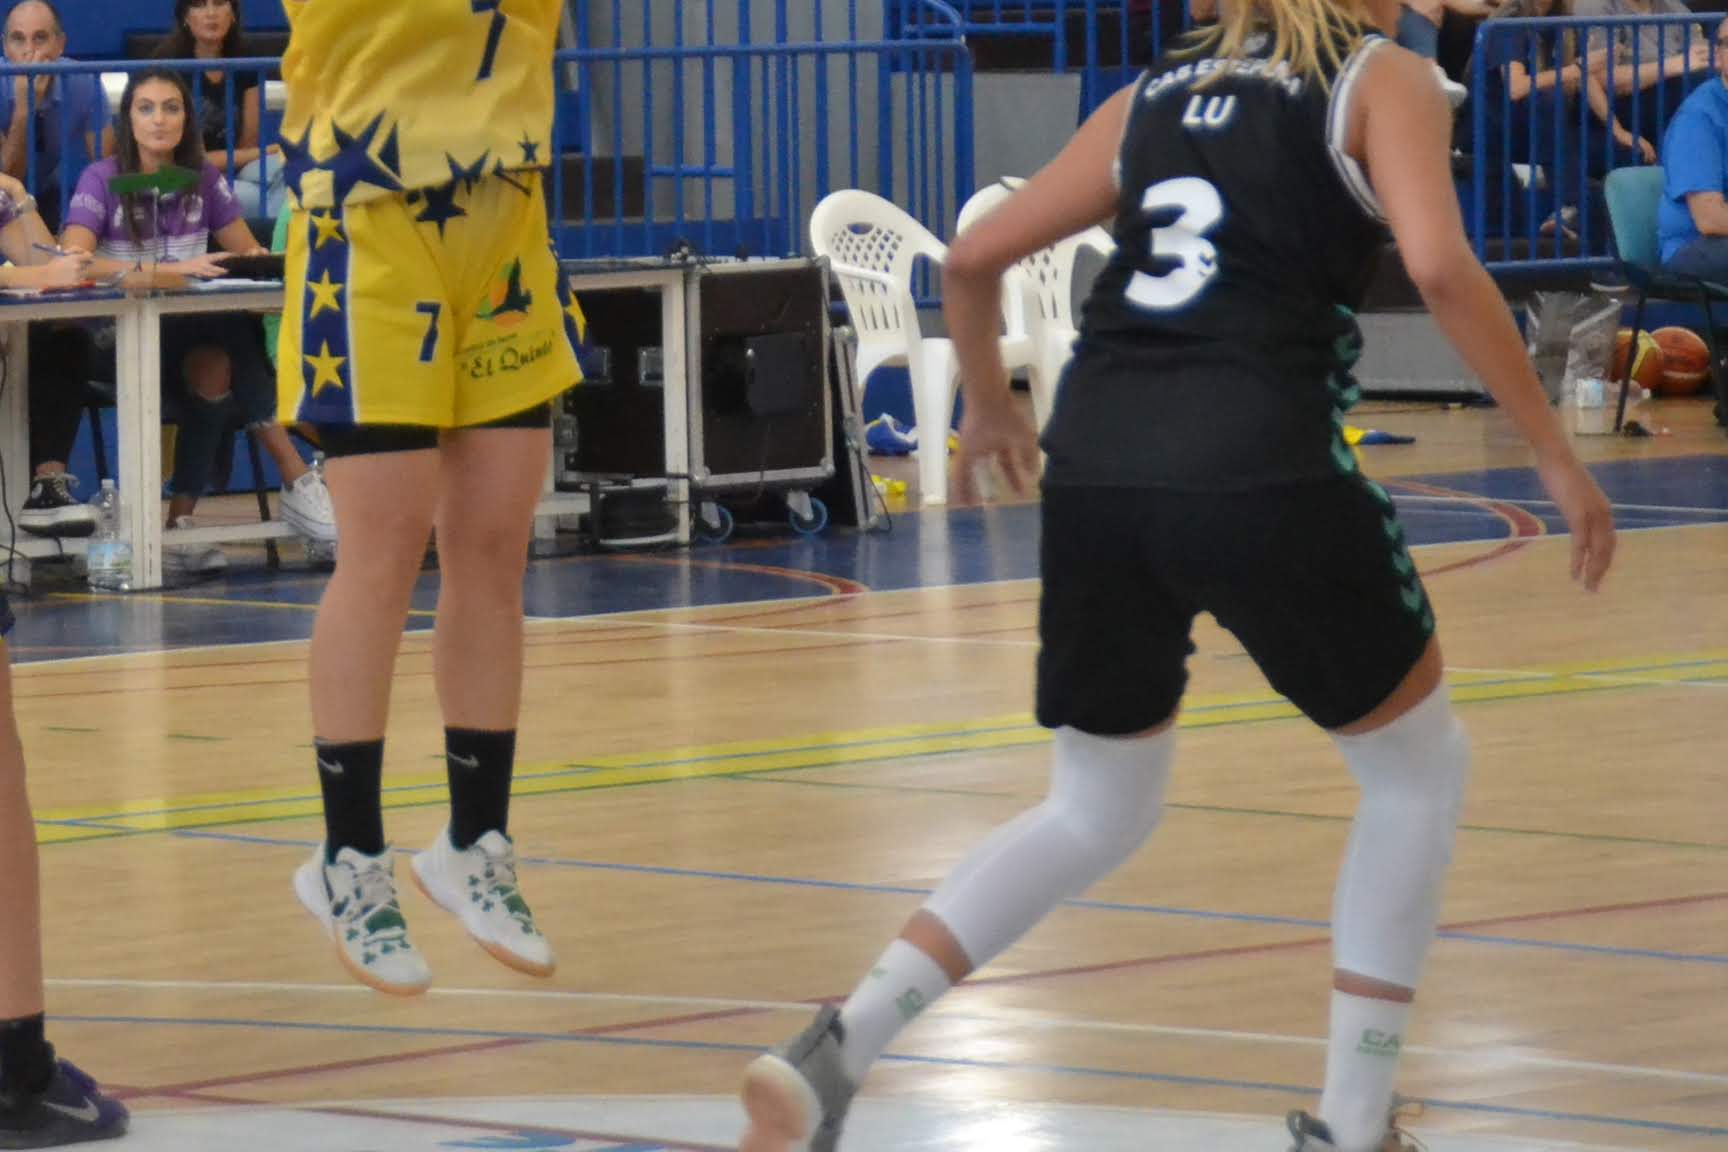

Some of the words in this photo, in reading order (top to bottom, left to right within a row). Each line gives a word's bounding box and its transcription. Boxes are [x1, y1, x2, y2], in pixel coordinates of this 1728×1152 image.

[1181, 94, 1237, 127] LU
[1124, 176, 1223, 307] 3
[415, 301, 442, 363] 7
